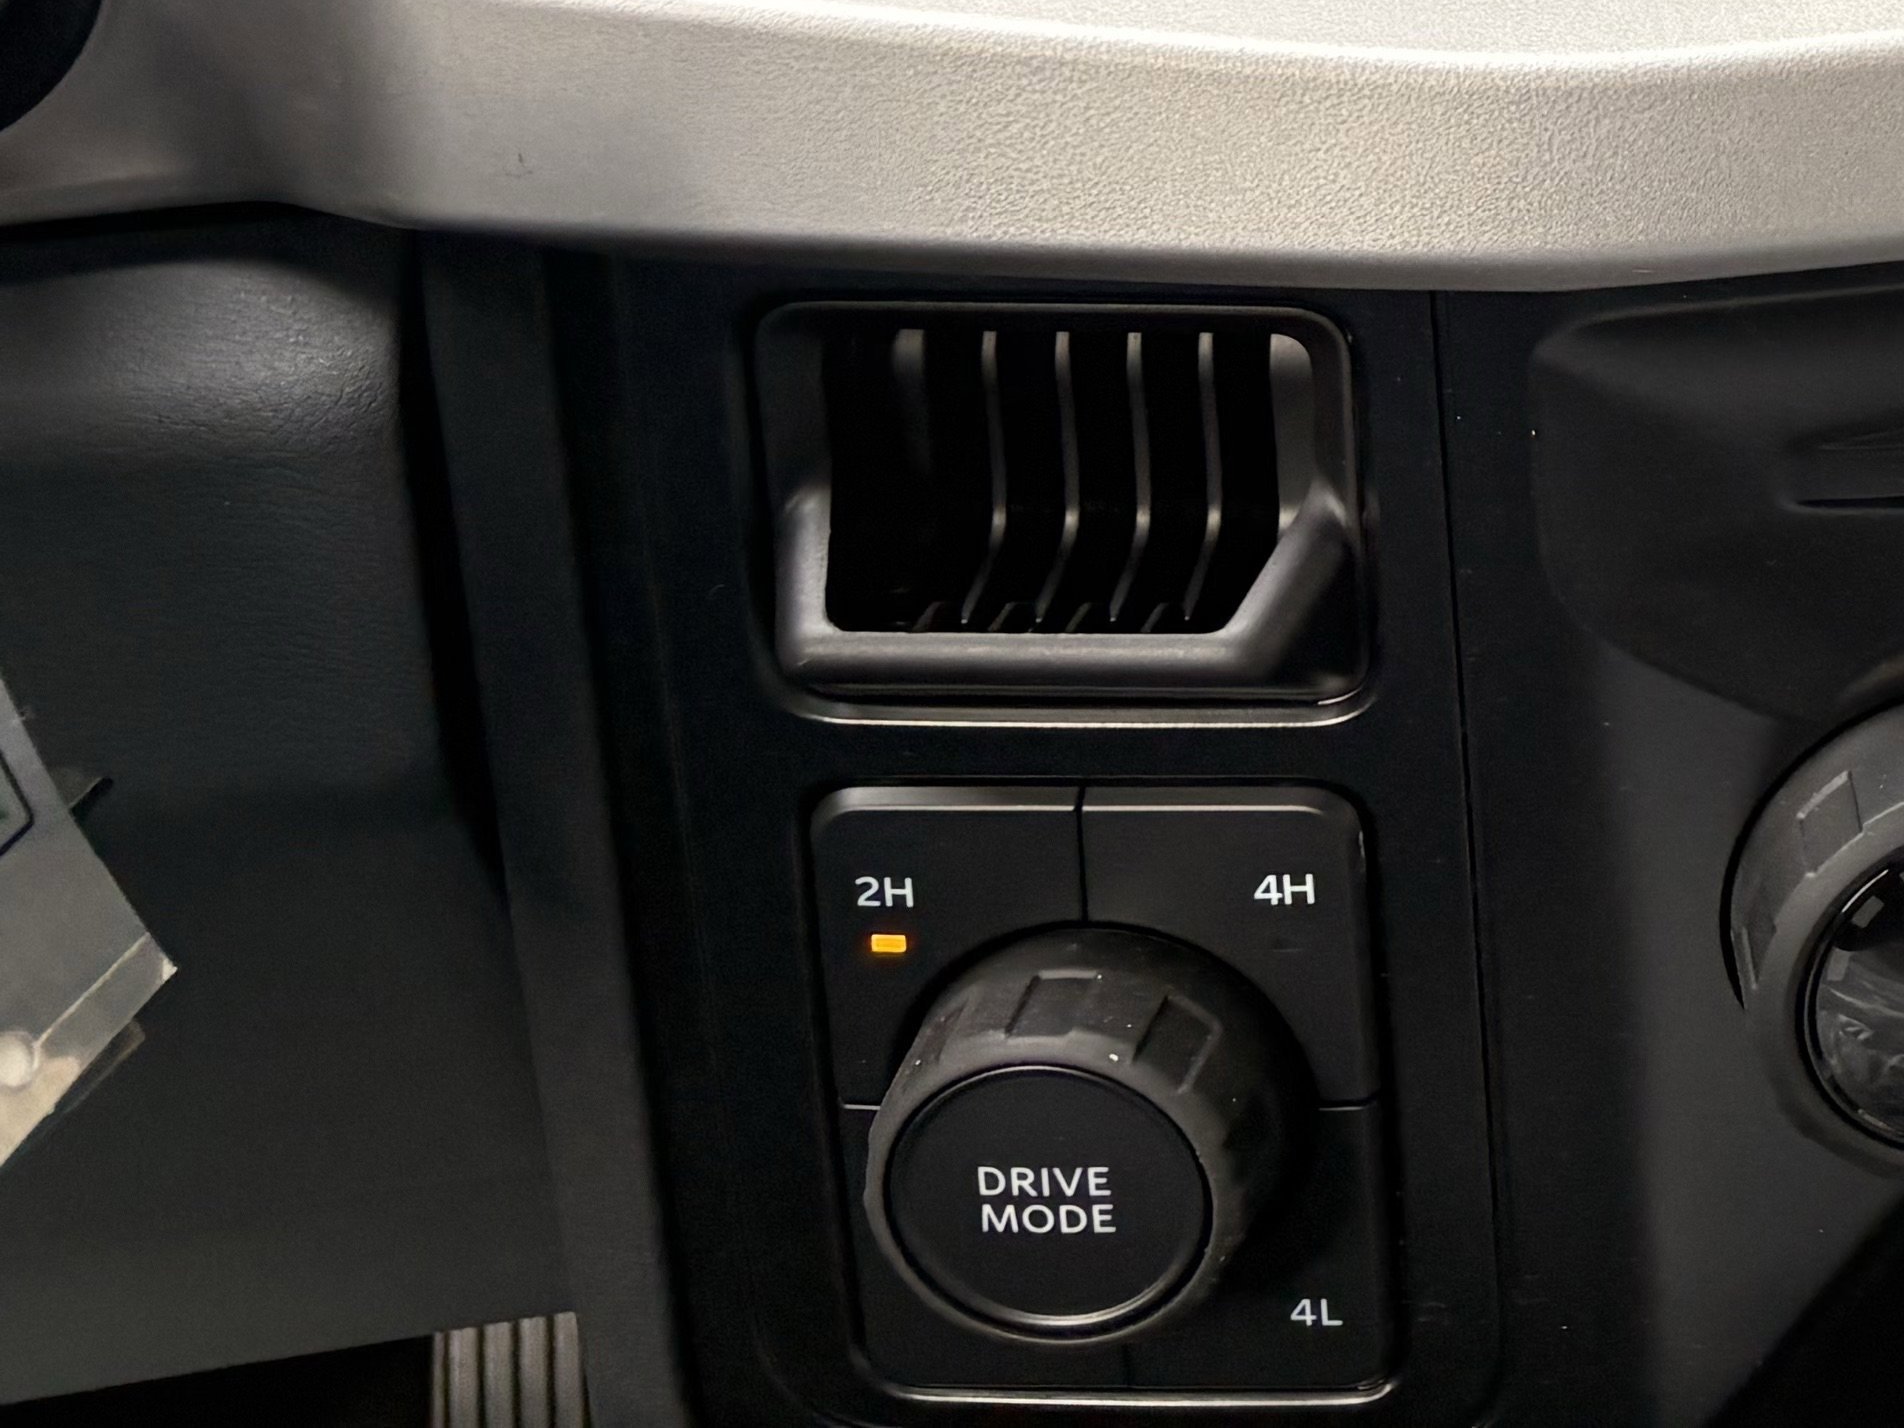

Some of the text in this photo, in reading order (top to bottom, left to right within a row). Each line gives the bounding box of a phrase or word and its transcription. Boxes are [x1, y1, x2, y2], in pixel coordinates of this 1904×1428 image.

[854, 875, 915, 909] 2H
[1253, 873, 1316, 906] 4H
[976, 1165, 1112, 1198] DRIVE
[981, 1204, 1116, 1234] MODE
[1290, 1298, 1344, 1327] 4L
